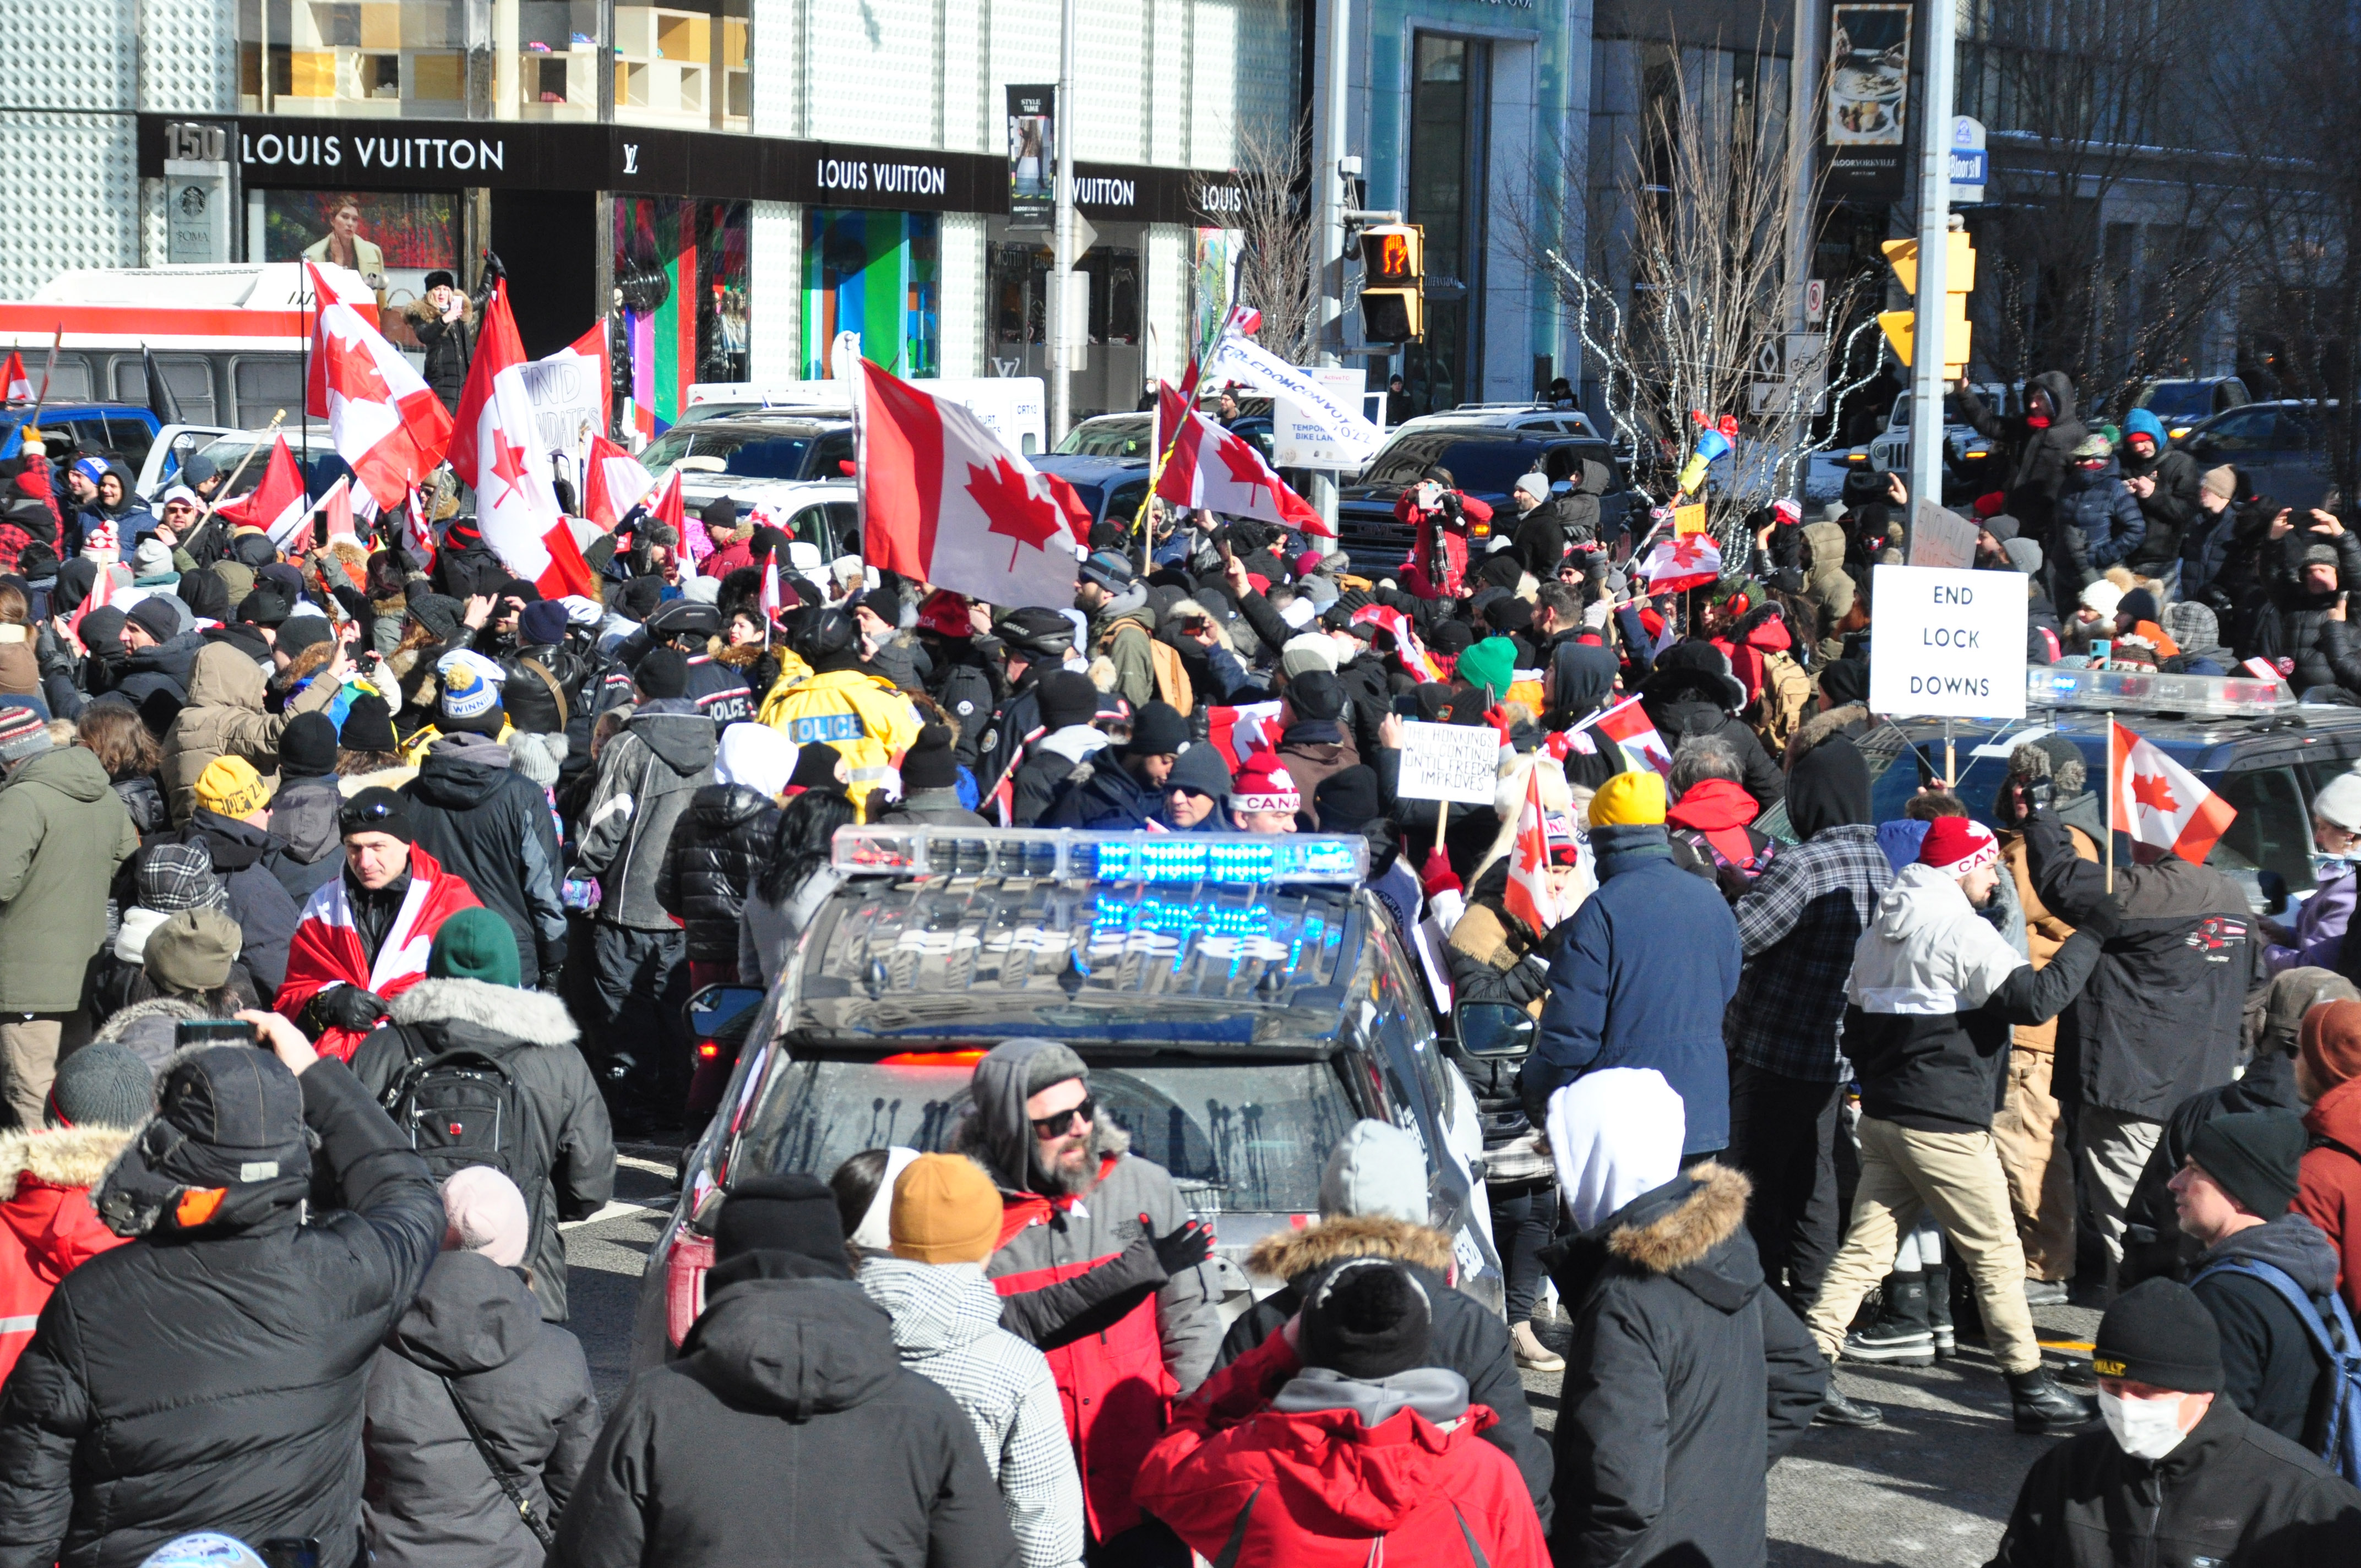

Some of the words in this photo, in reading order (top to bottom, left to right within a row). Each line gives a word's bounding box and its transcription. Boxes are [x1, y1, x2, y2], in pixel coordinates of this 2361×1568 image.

[165, 123, 225, 160] 150
[243, 134, 341, 165] LOUIS
[355, 138, 503, 171] VUITTON
[818, 159, 867, 190] LOUIS
[873, 163, 945, 194] VUITTON
[1975, 155, 1982, 178] W
[1203, 185, 1241, 212] LOUIS
[1316, 433, 1335, 442] LAN
[1934, 586, 1973, 605] END
[1924, 628, 1979, 649] LOCK
[1911, 676, 1989, 697] DOWNS
[1405, 726, 1427, 740] THE
[1433, 728, 1494, 748] HONKINGS
[1405, 742, 1434, 755] WILL
[1439, 743, 1497, 763] CONTINUE
[1405, 754, 1445, 770] UNTIL
[1449, 759, 1499, 778] FREEDOM
[1421, 770, 1484, 791] IMPROVES
[1247, 797, 1300, 809] CANA
